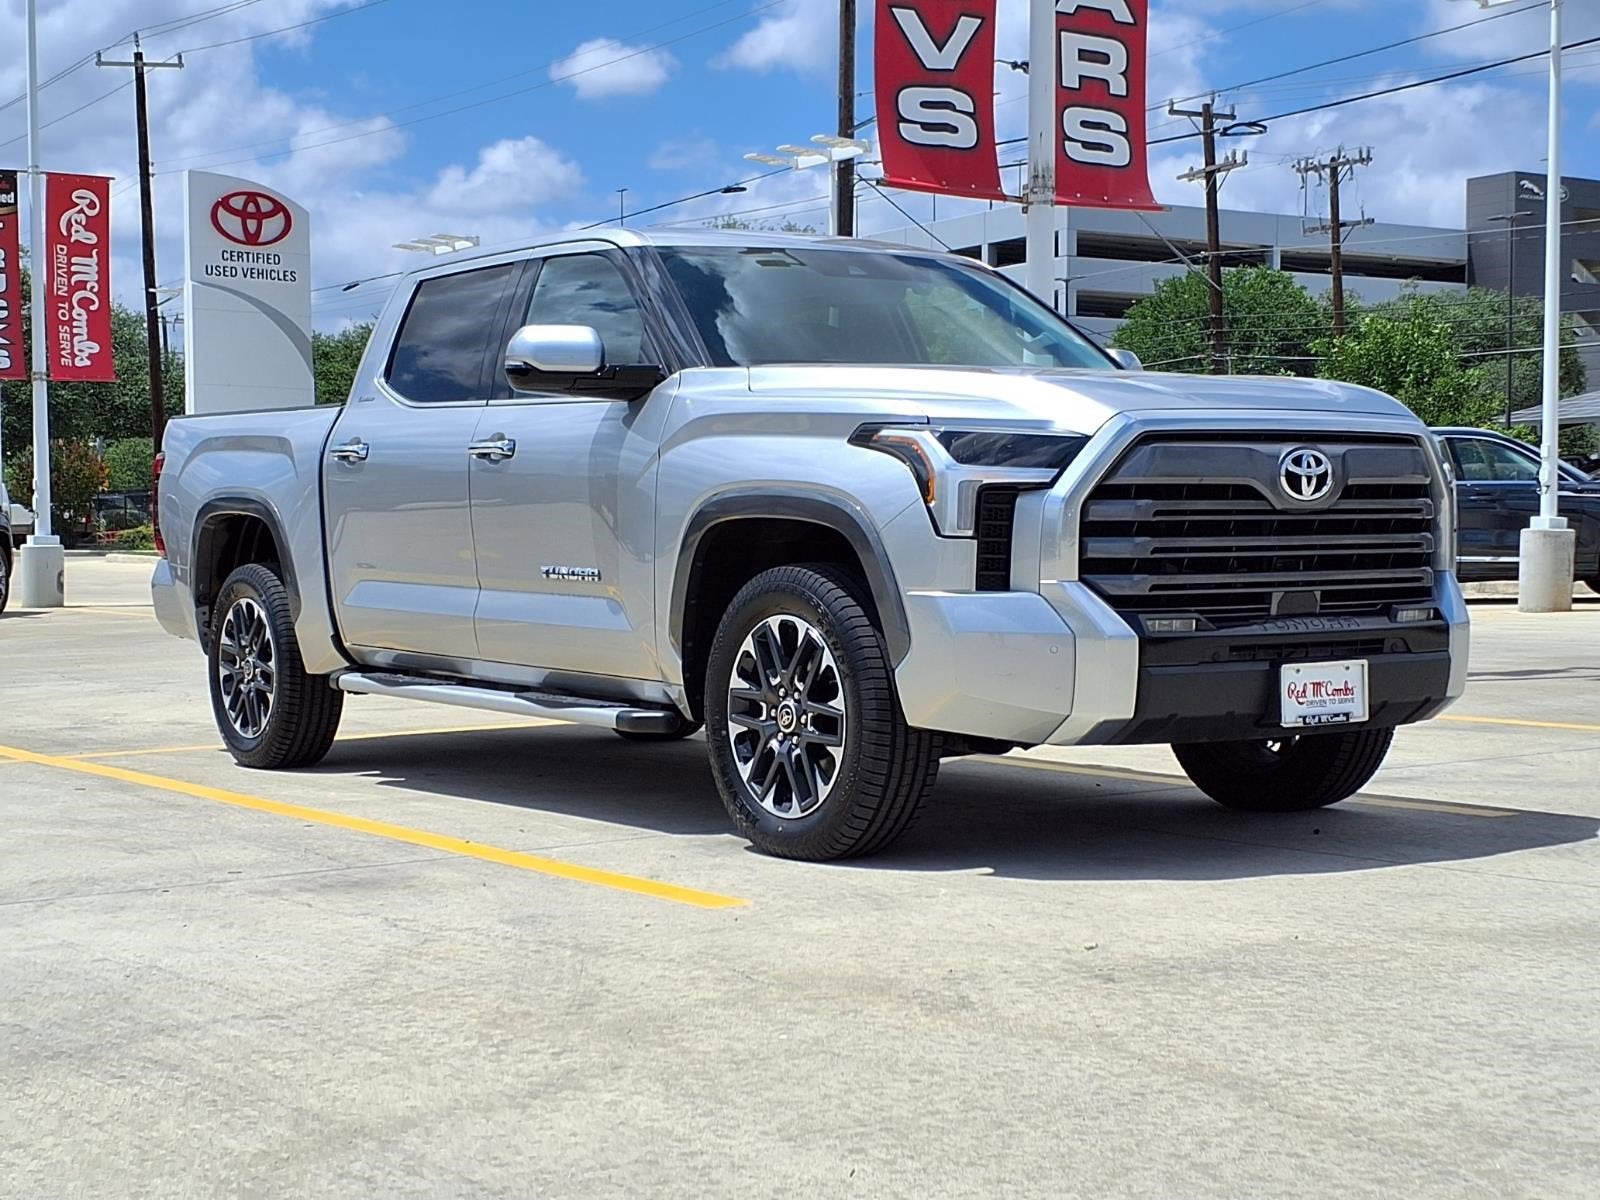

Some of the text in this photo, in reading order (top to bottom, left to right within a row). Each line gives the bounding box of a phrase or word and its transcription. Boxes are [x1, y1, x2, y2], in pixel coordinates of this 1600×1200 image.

[0, 192, 15, 204] ed
[221, 249, 281, 265] CERTIFIED
[60, 189, 101, 367] Red McCombs
[205, 264, 297, 282] USED VEHICLES
[57, 244, 72, 367] DRIVEN TO SERVE
[540, 565, 601, 582] TUNDRA
[1287, 680, 1355, 706] Red McCombs
[1306, 699, 1328, 707] DRIVEN
